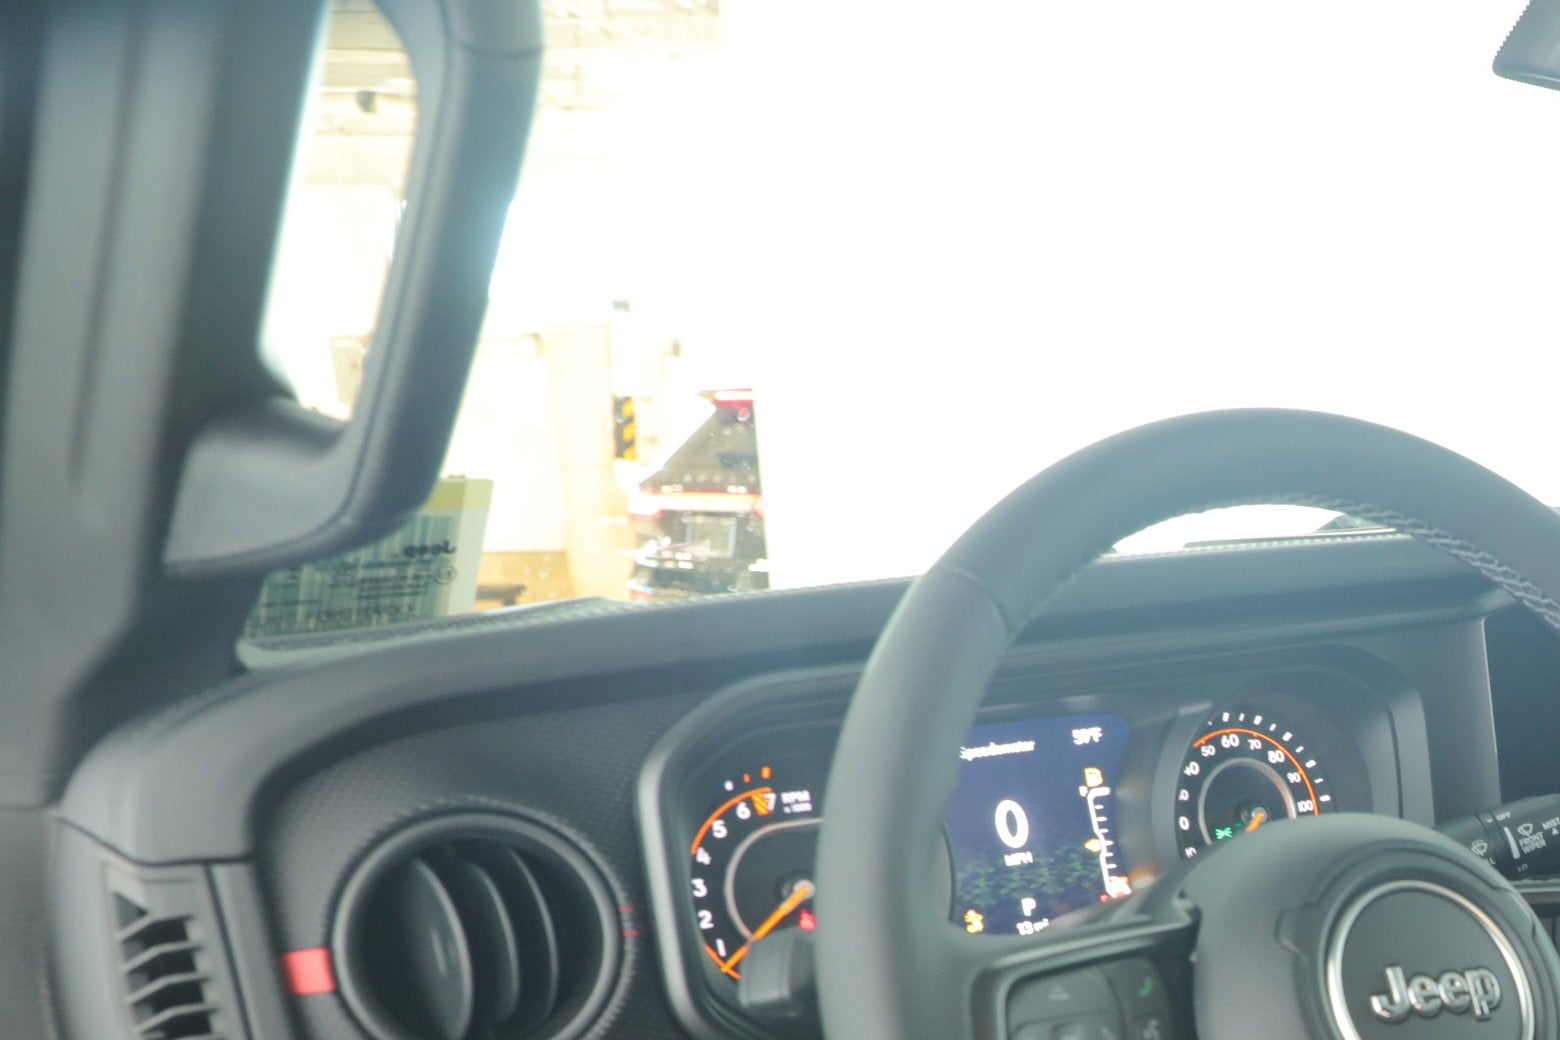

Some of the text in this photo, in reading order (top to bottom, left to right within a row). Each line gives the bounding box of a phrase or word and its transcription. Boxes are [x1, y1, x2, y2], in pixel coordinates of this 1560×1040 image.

[1220, 733, 1240, 748] 60
[1247, 739, 1262, 750] 70
[1200, 744, 1216, 757] 50
[1267, 750, 1285, 764] 80
[1184, 761, 1200, 776] 40
[1286, 772, 1301, 784] 90
[762, 793, 777, 811] 7
[1297, 800, 1314, 813] 100
[736, 801, 751, 820] 6
[1496, 811, 1512, 822] OFF
[711, 820, 728, 839] 5
[994, 799, 1029, 849] 0
[1541, 817, 1560, 831] MIST
[1519, 831, 1544, 847] FRONT
[1522, 839, 1547, 854] WIPER
[696, 847, 711, 865] 4
[691, 878, 707, 897] 3
[1021, 897, 1037, 917] P
[697, 909, 714, 929] 2
[715, 938, 727, 957] 1
[1370, 964, 1501, 1024] Jeep
